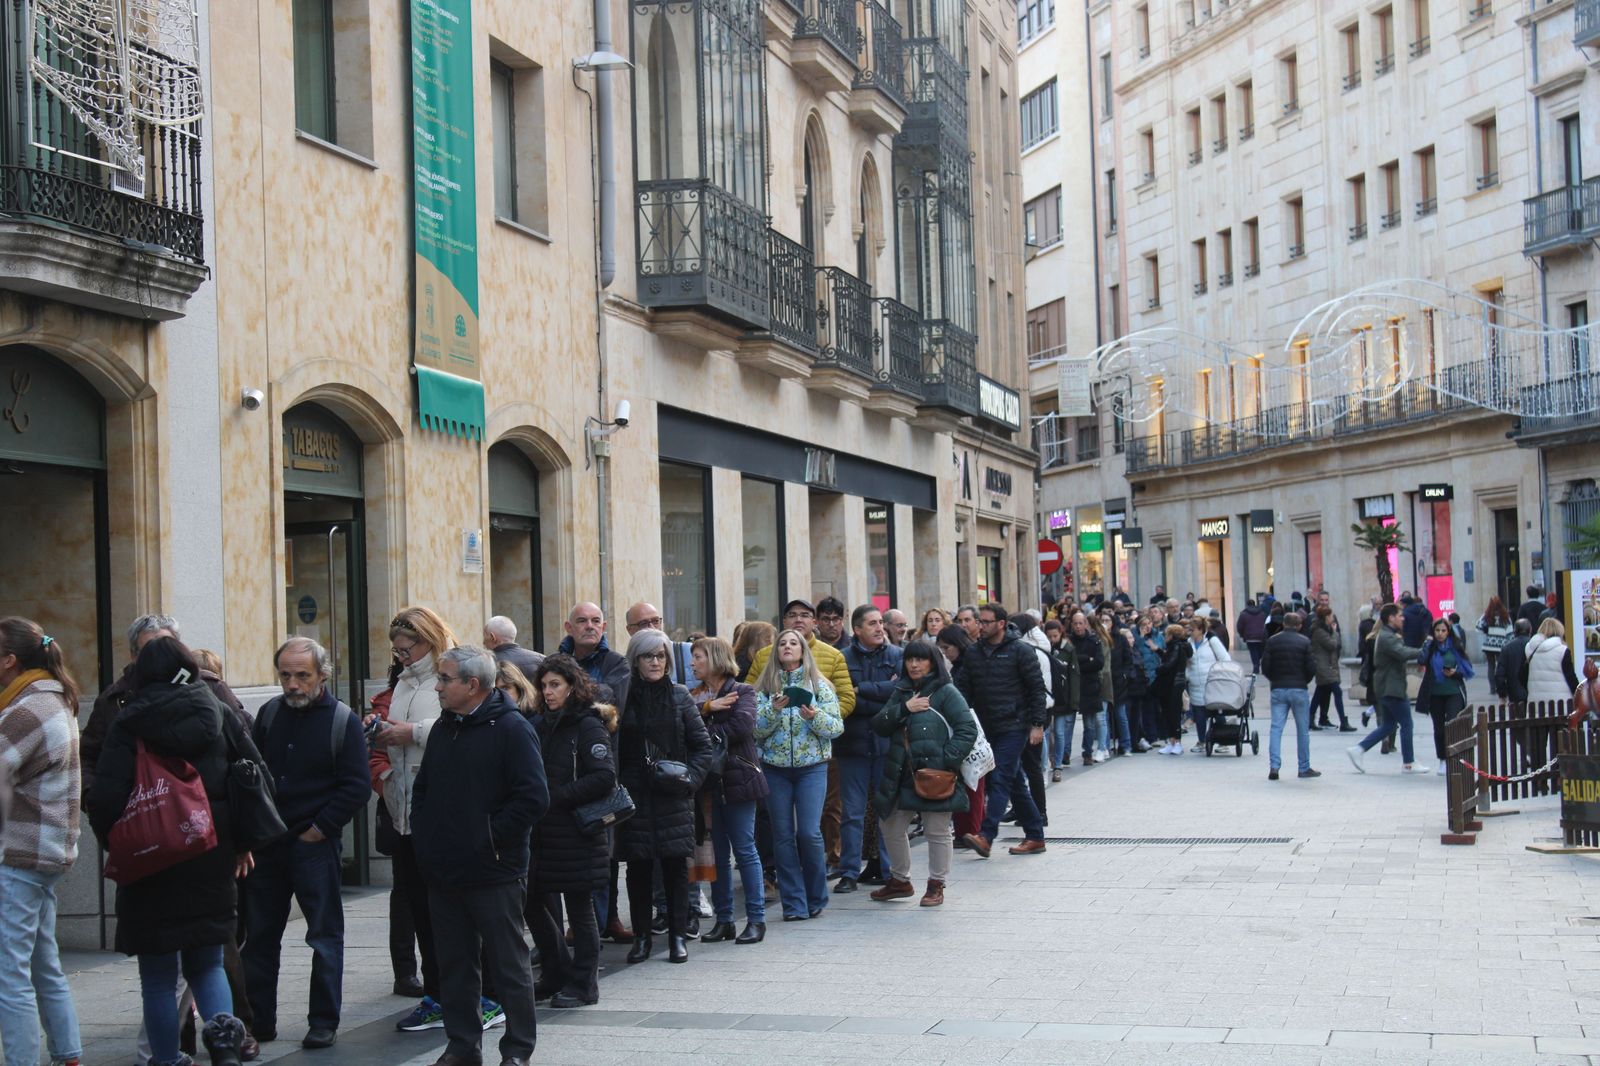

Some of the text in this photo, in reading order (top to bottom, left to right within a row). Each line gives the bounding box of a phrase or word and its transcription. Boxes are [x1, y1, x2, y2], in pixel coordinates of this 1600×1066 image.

[291, 427, 340, 460] TABACOS
[1425, 488, 1445, 497] DRUNI
[1202, 520, 1228, 537] MANGO
[1562, 778, 1600, 803] SALIDA
